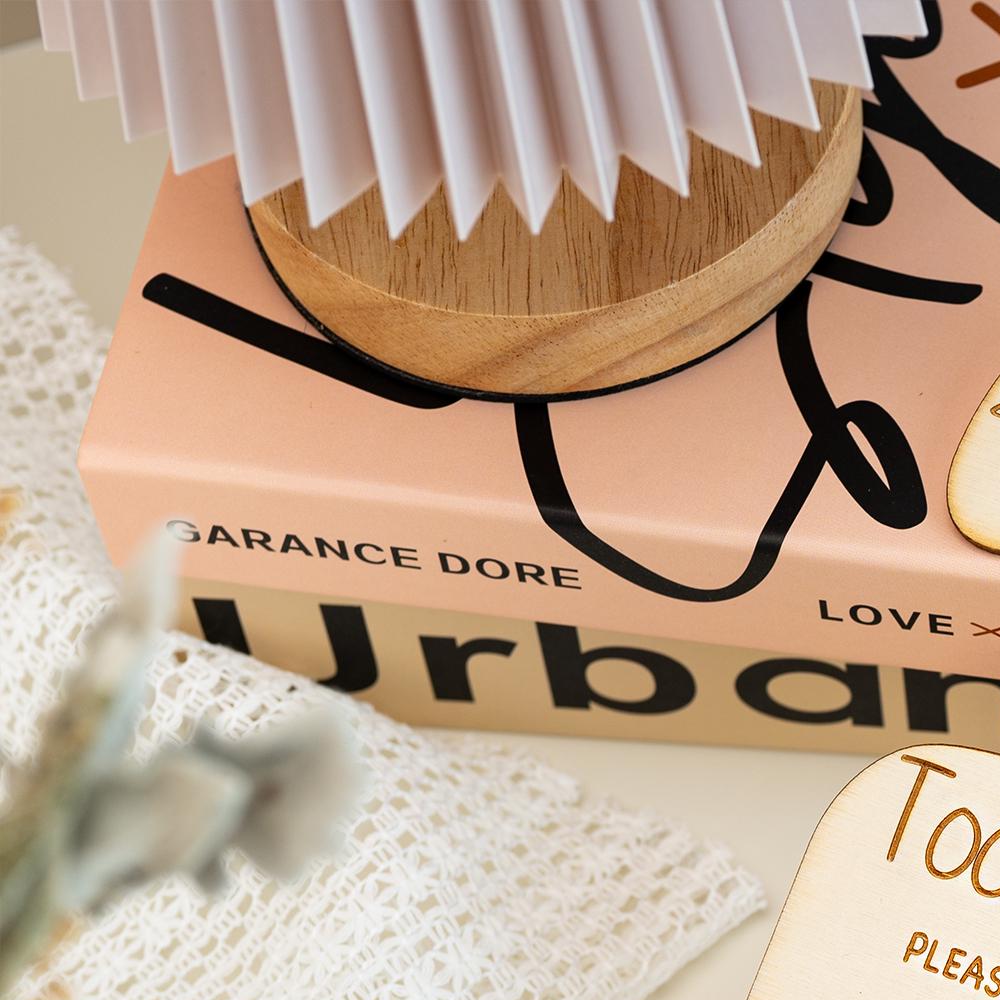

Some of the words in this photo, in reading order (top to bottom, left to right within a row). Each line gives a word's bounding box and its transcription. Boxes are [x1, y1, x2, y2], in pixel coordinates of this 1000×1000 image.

[165, 519, 422, 570] GARANCE
[437, 551, 583, 590] DORE
[818, 599, 955, 636] LOVE
